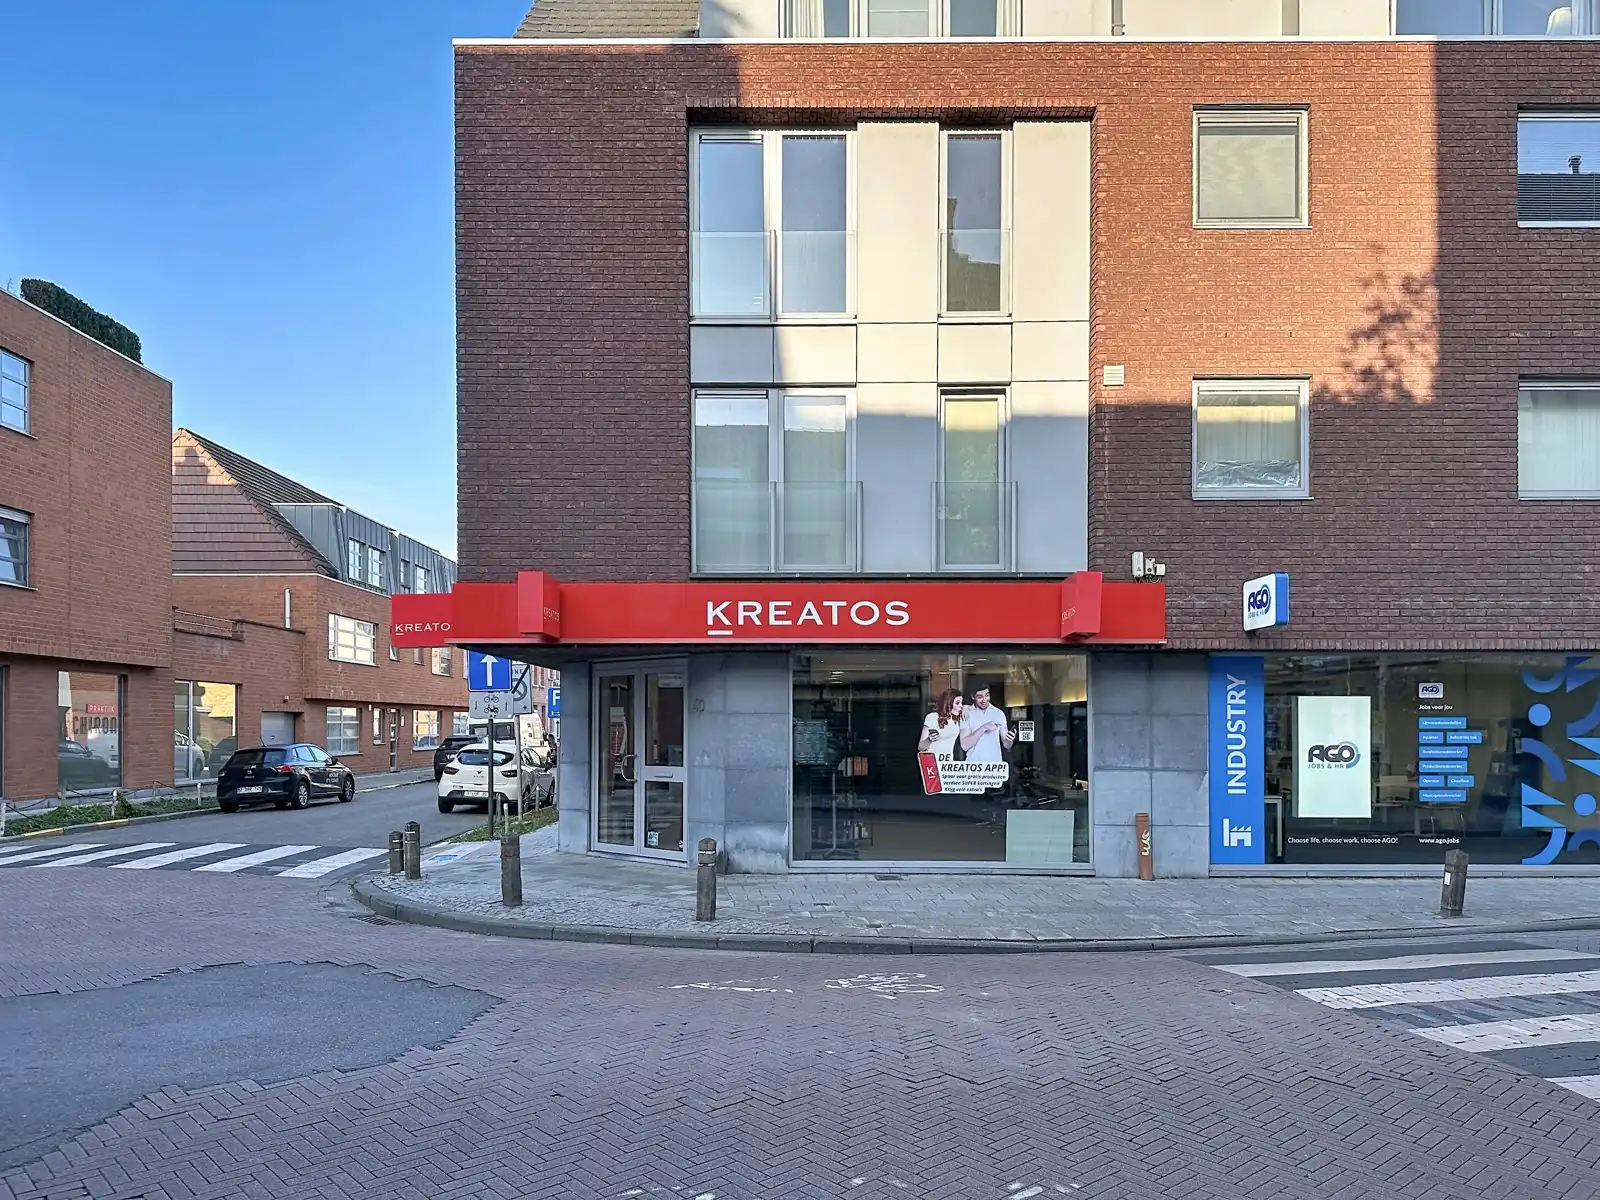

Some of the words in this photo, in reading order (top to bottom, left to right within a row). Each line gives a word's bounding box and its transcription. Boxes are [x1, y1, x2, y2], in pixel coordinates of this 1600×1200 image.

[1248, 588, 1269, 612] AGO
[706, 600, 910, 626] KREATOS
[395, 622, 452, 633] KREATO
[1226, 673, 1247, 795] INDUSTRY
[938, 753, 951, 762] DE
[1308, 744, 1356, 763] AGO
[940, 763, 982, 772] KREATOS
[984, 763, 1006, 772] APP!
[1418, 837, 1460, 845] www.ago.jobs
